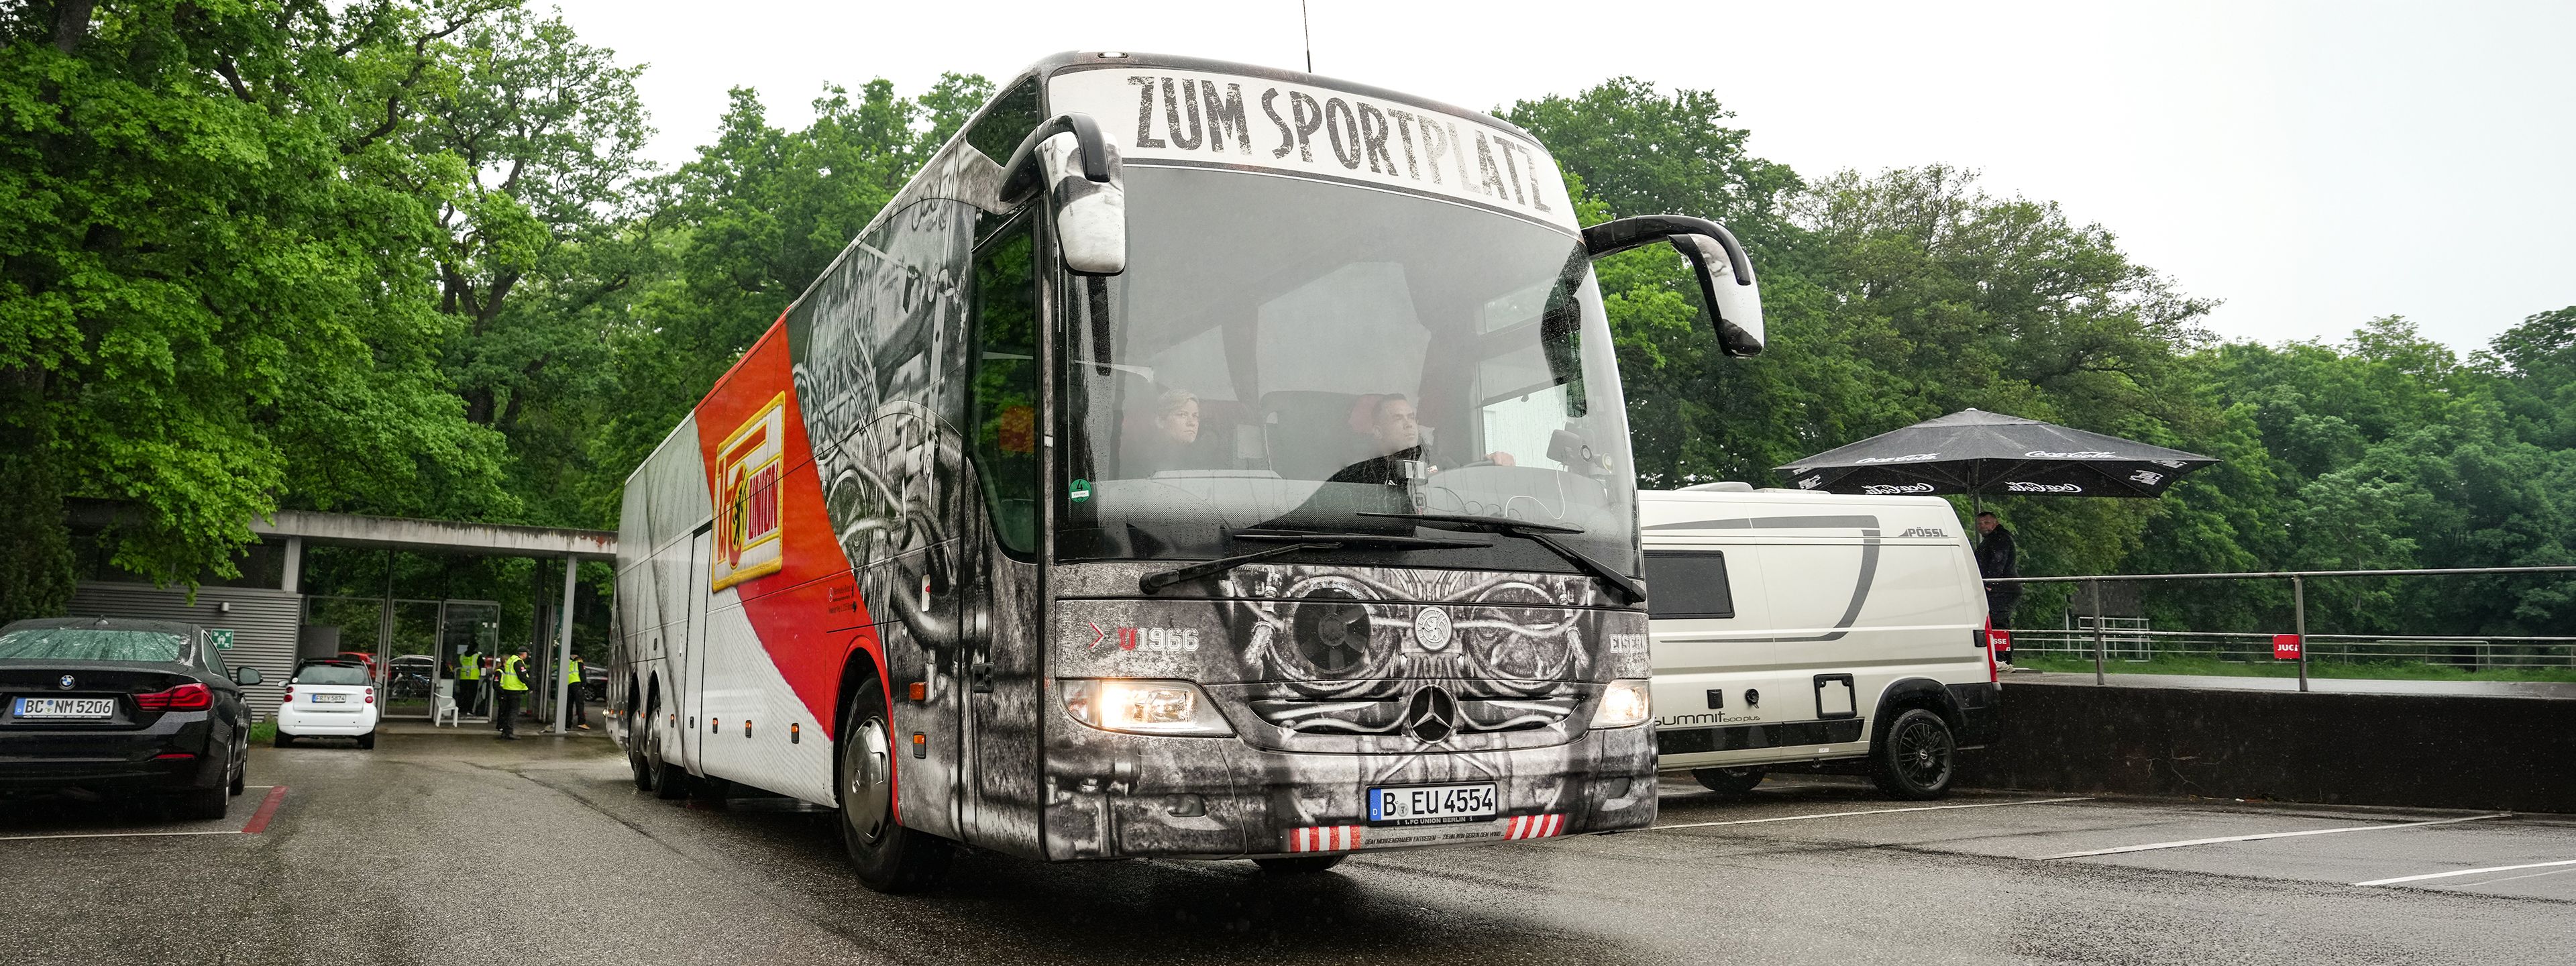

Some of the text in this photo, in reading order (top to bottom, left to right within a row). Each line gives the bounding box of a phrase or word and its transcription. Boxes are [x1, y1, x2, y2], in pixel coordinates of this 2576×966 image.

[1127, 76, 1552, 215] ZUM SPORTPLATZ
[2025, 450, 2118, 458] Coca-Cola
[1077, 480, 1083, 490] 4
[748, 462, 779, 540] UNION
[1907, 527, 1948, 537] PÖSSL
[1609, 634, 1648, 653] EISERN
[25, 700, 111, 714] BC NM 5206
[1383, 788, 1493, 816] B EU 4554
